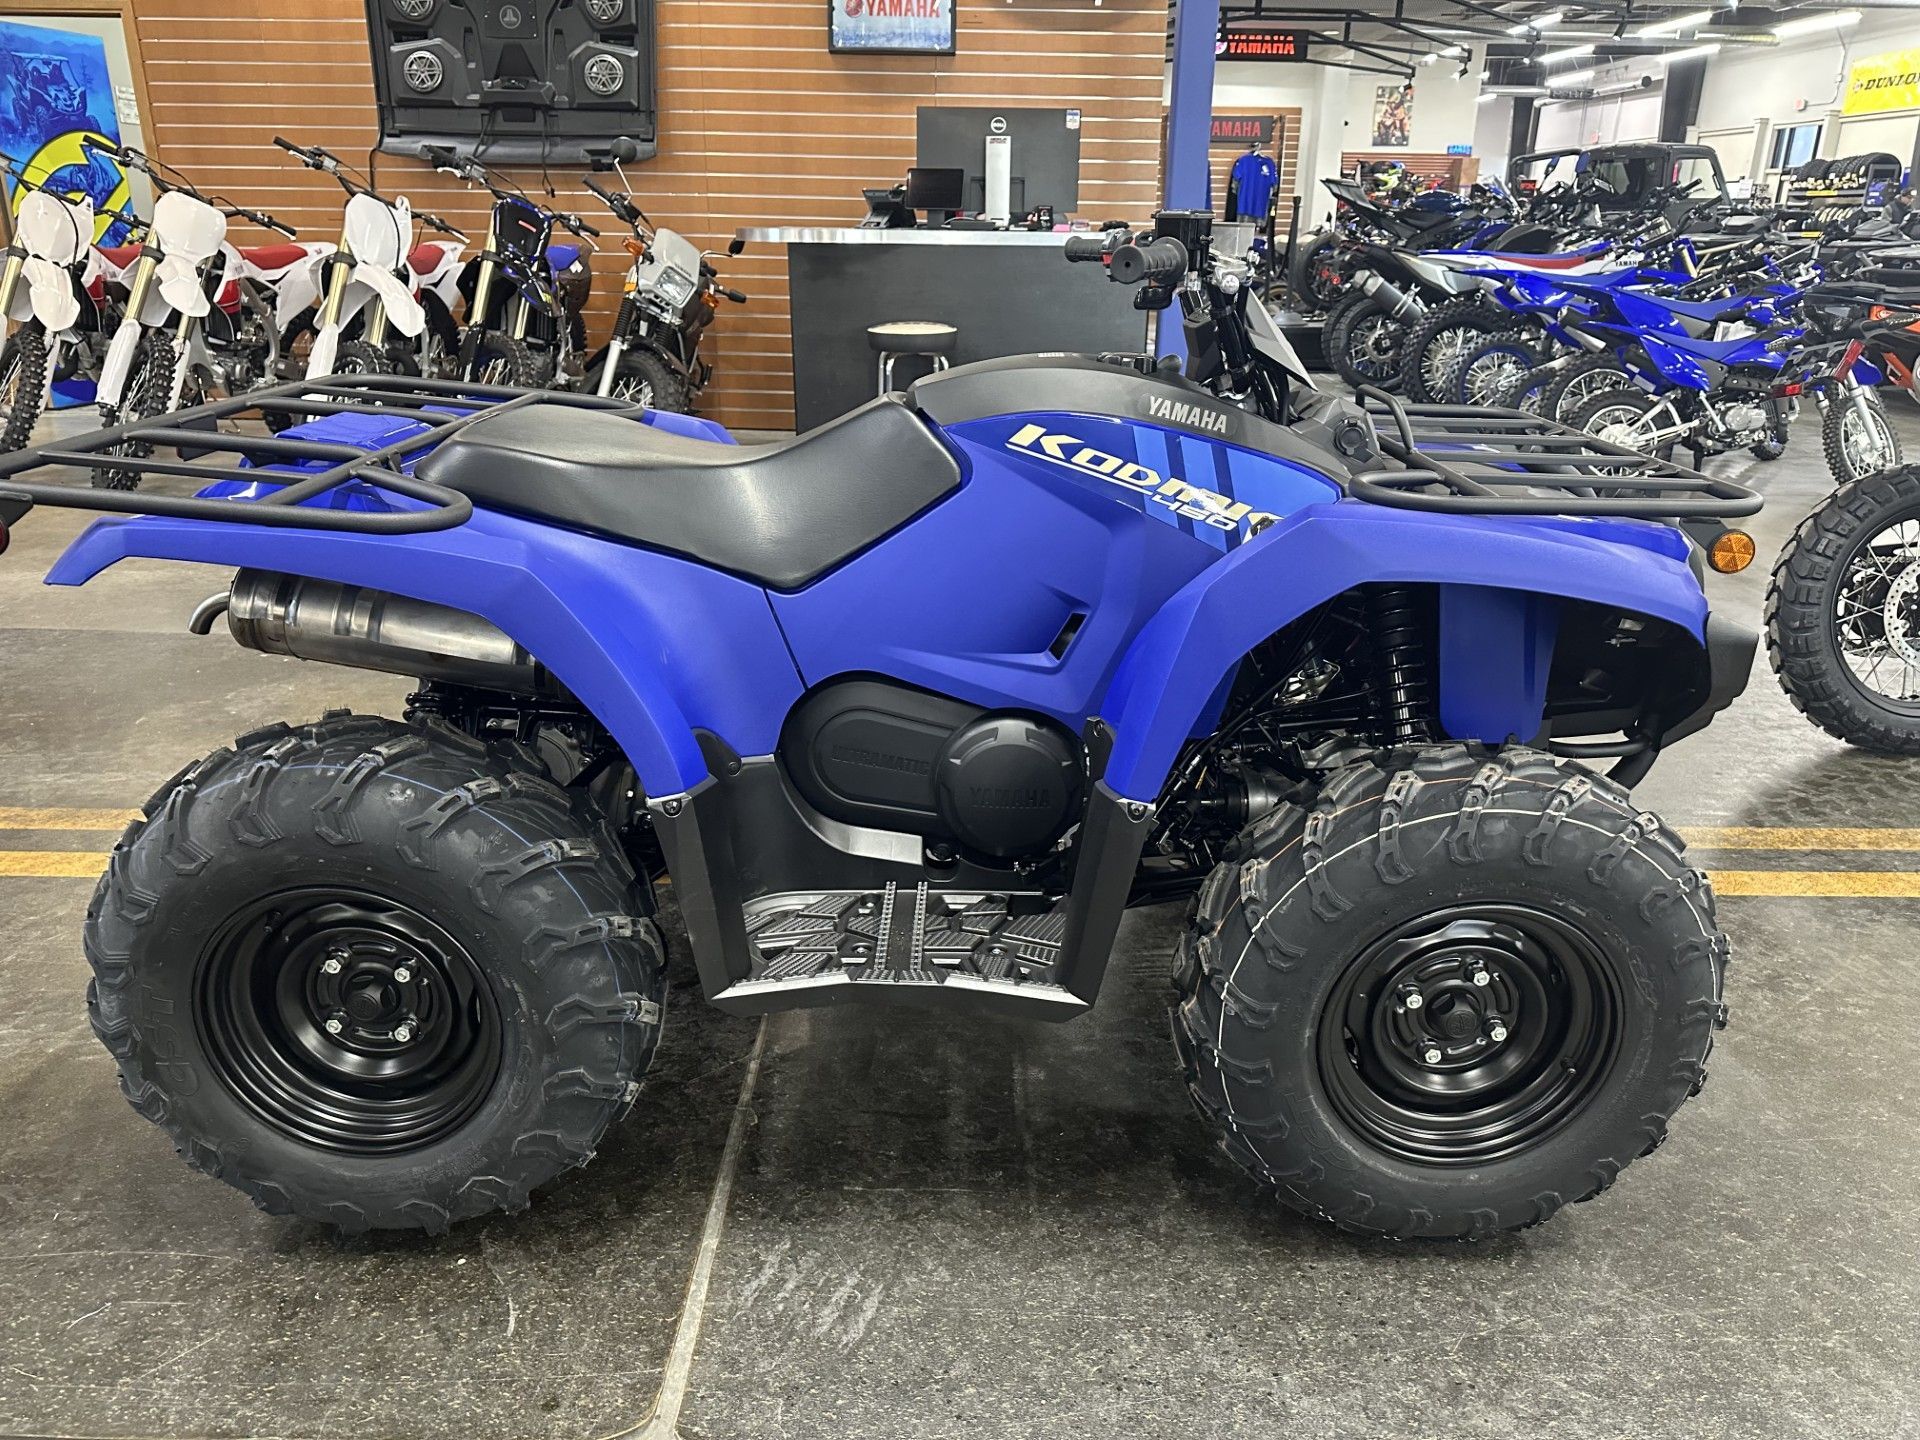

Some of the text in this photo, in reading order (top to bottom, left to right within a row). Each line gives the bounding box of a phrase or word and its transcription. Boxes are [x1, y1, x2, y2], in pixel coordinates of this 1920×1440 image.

[865, 0, 941, 18] YAMAHA
[1227, 34, 1296, 55] YAMAHA
[1864, 72, 1920, 91] DUNLO
[1211, 121, 1262, 137] AMAHA
[1149, 395, 1228, 434] YAMAHA
[1151, 494, 1238, 531] 450
